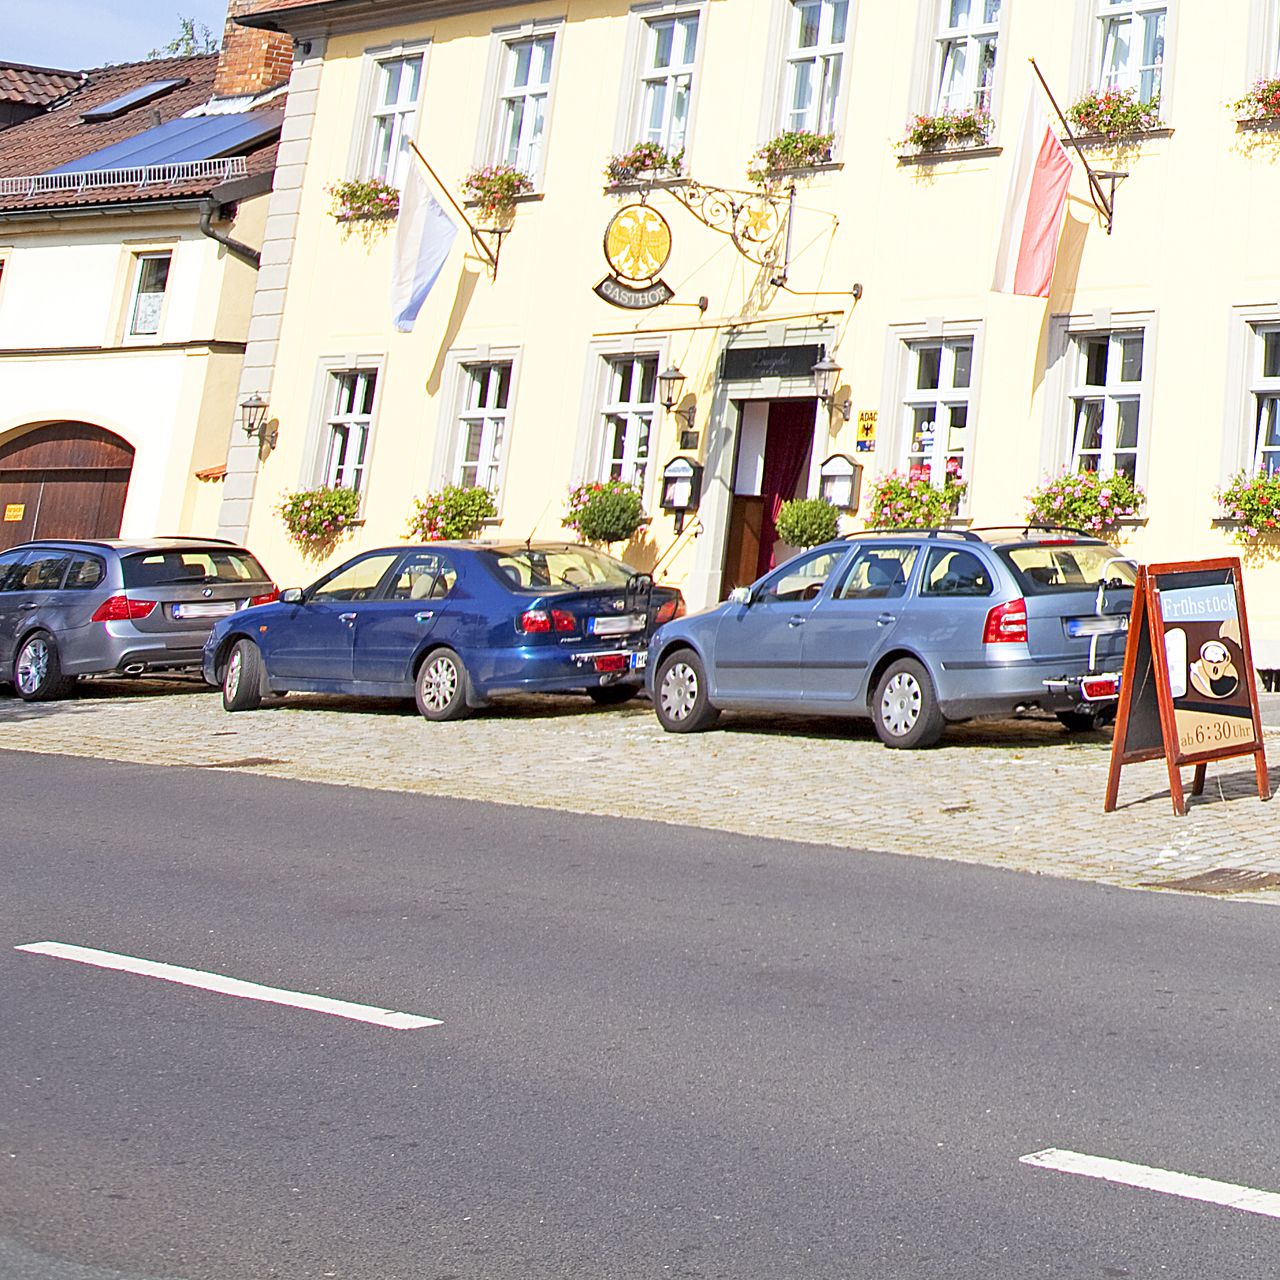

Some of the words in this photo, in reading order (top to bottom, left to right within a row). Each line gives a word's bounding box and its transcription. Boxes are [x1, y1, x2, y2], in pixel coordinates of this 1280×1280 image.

[601, 281, 666, 306] GASTHOF
[860, 411, 878, 422] ADAC
[1163, 592, 1236, 618] Frühstück
[1181, 732, 1194, 747] ab
[1195, 720, 1231, 744] 6:30
[1232, 724, 1251, 738] Uhr
